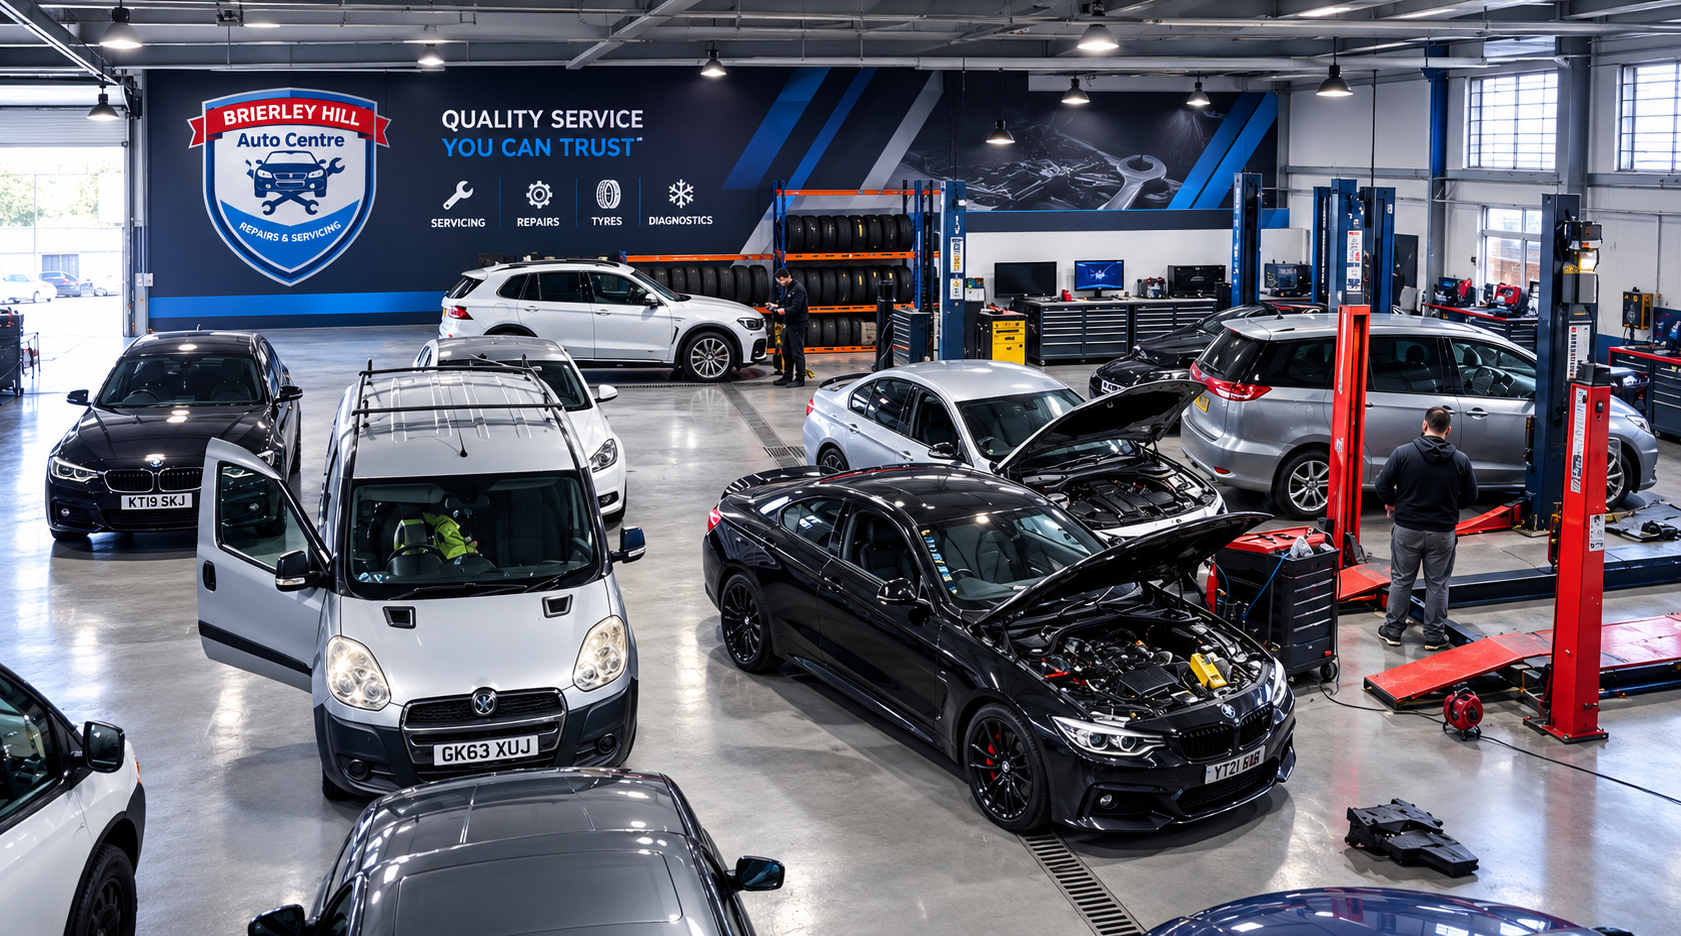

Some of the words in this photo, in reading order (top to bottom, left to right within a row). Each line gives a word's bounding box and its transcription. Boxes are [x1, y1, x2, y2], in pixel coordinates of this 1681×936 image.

[223, 104, 317, 126] BRIERLEY
[321, 105, 360, 126] HILL
[441, 109, 544, 132] QUALITY
[551, 109, 643, 129] SERVICE
[236, 132, 281, 148] Auto
[284, 132, 345, 148] Centre
[441, 137, 493, 157] YOU
[501, 137, 551, 157] CAN
[431, 218, 486, 228] SERVICING
[517, 217, 560, 227] REPAIRS
[591, 216, 623, 226] TYRES
[648, 215, 713, 226] DIAGNOSTICS
[239, 221, 279, 242] REPAIRS
[281, 233, 289, 242] &
[291, 220, 342, 242] SERVICING
[128, 496, 158, 508] KT19
[161, 494, 185, 507] SKJ
[441, 743, 490, 762] GK63
[495, 738, 531, 758] XUJ
[1214, 759, 1240, 780] YT21
